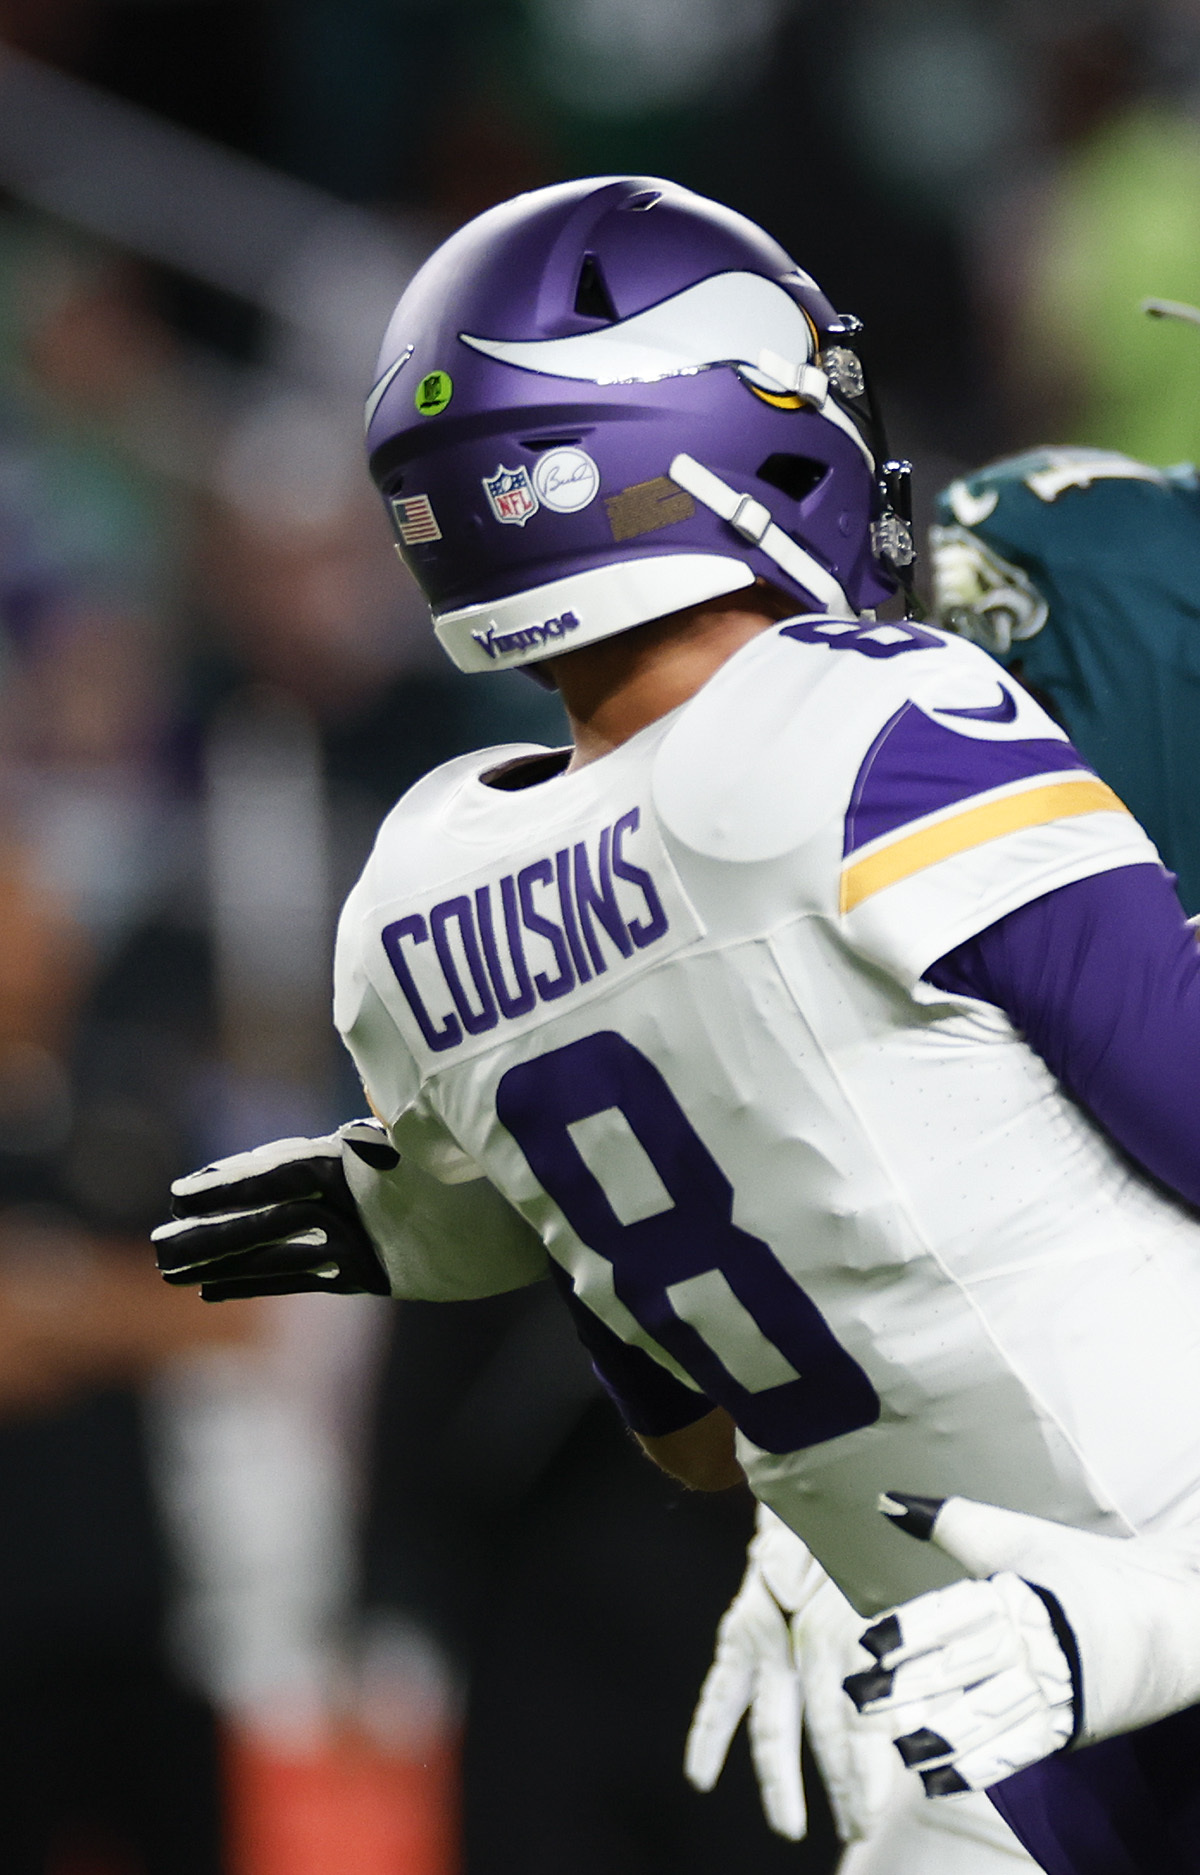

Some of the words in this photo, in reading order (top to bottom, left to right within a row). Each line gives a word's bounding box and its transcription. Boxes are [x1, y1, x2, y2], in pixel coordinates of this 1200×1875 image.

[497, 490, 533, 517] NFL
[779, 620, 947, 658] 8
[380, 804, 670, 1053] COUSINS
[495, 1029, 881, 1456] 8
